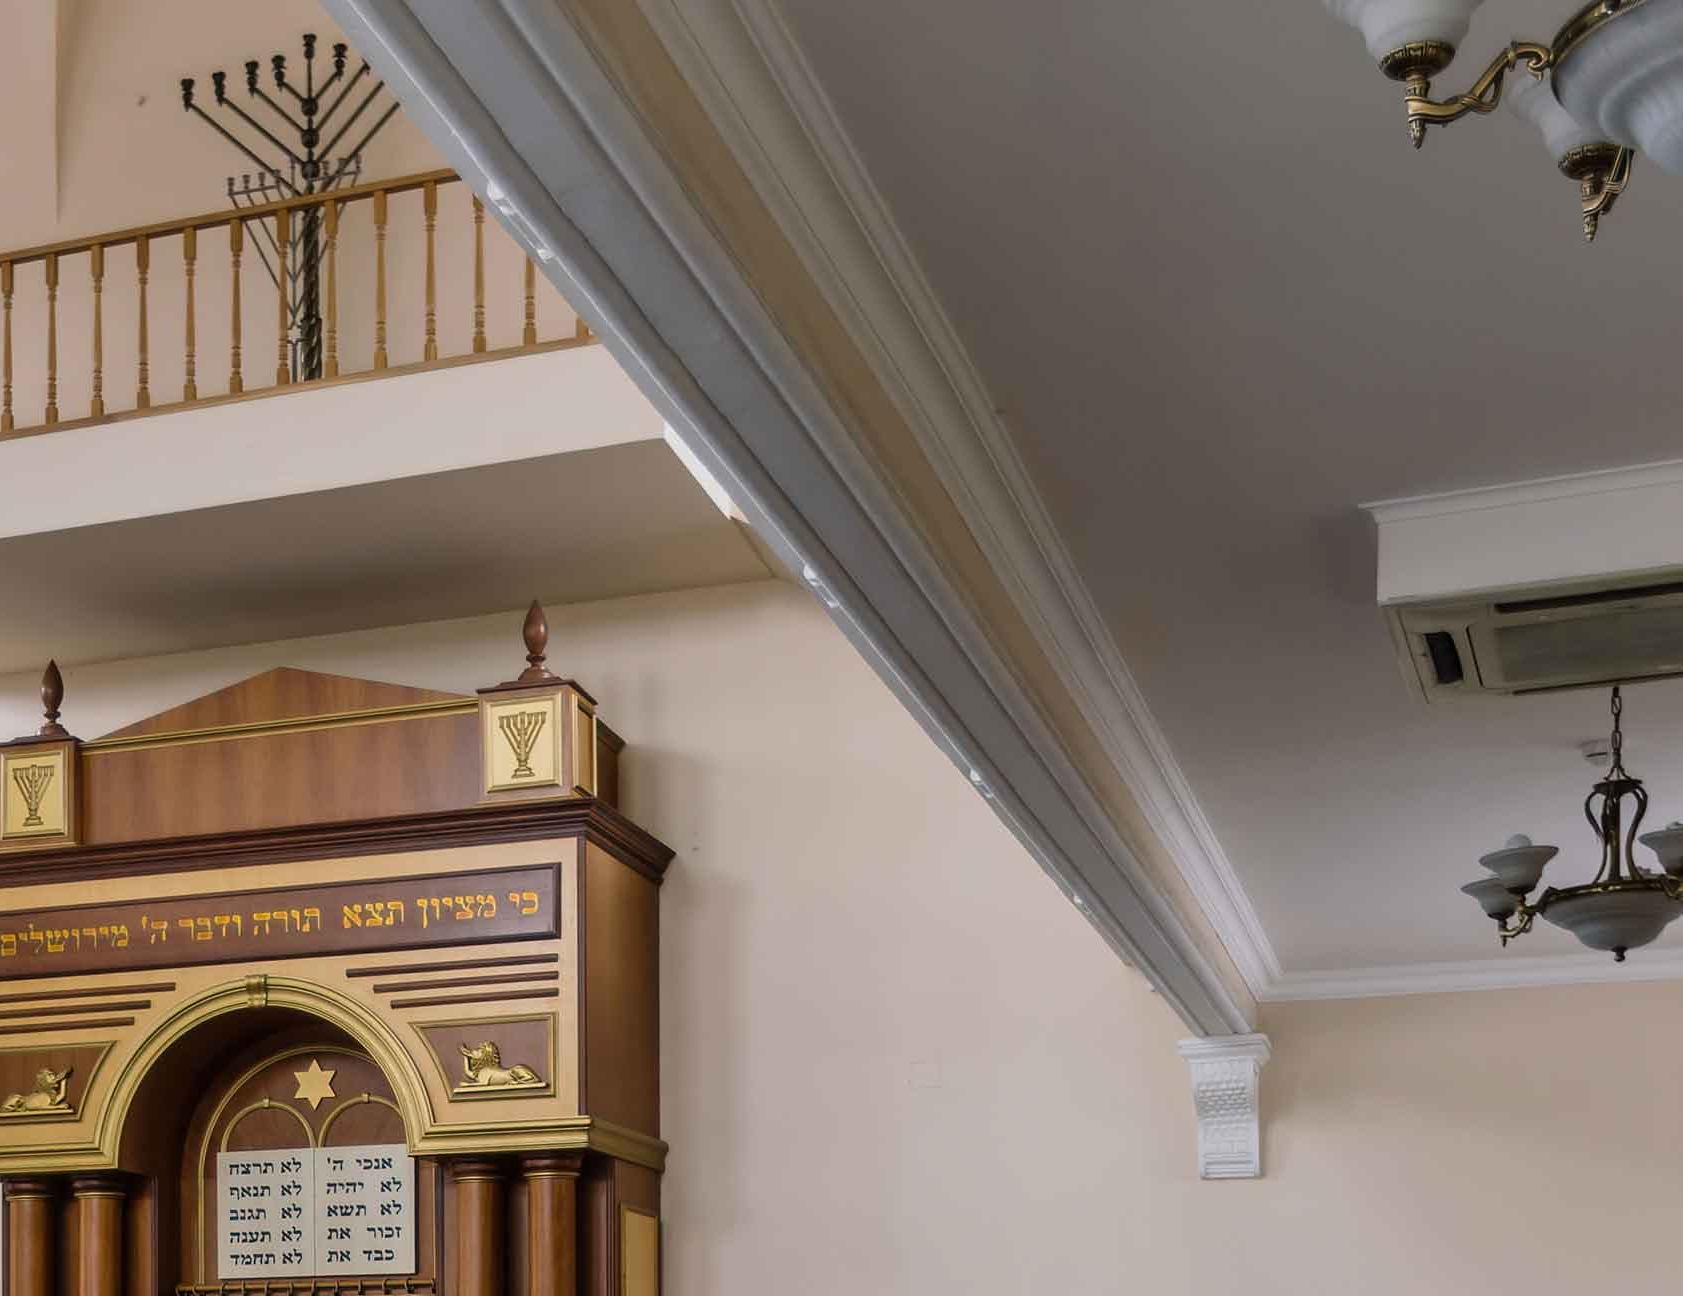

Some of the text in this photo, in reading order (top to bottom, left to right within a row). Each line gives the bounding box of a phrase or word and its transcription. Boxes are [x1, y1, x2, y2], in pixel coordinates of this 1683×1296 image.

[416, 894, 496, 928] מציון
[508, 890, 540, 915] כי
[250, 906, 321, 937] תורה
[340, 899, 404, 929] תצא
[175, 911, 244, 943] ודבר
[228, 1156, 303, 1176] לא תרצח
[354, 1156, 394, 1171] אנכי
[228, 1179, 303, 1201] לא תנאף
[325, 1175, 404, 1196] לא יהיה
[280, 1202, 304, 1220] לא
[325, 1199, 404, 1219] לא תשא
[280, 1225, 304, 1243] לא
[326, 1225, 404, 1240] זכור את
[281, 1248, 304, 1266] לא
[325, 1248, 396, 1263] כבד את
